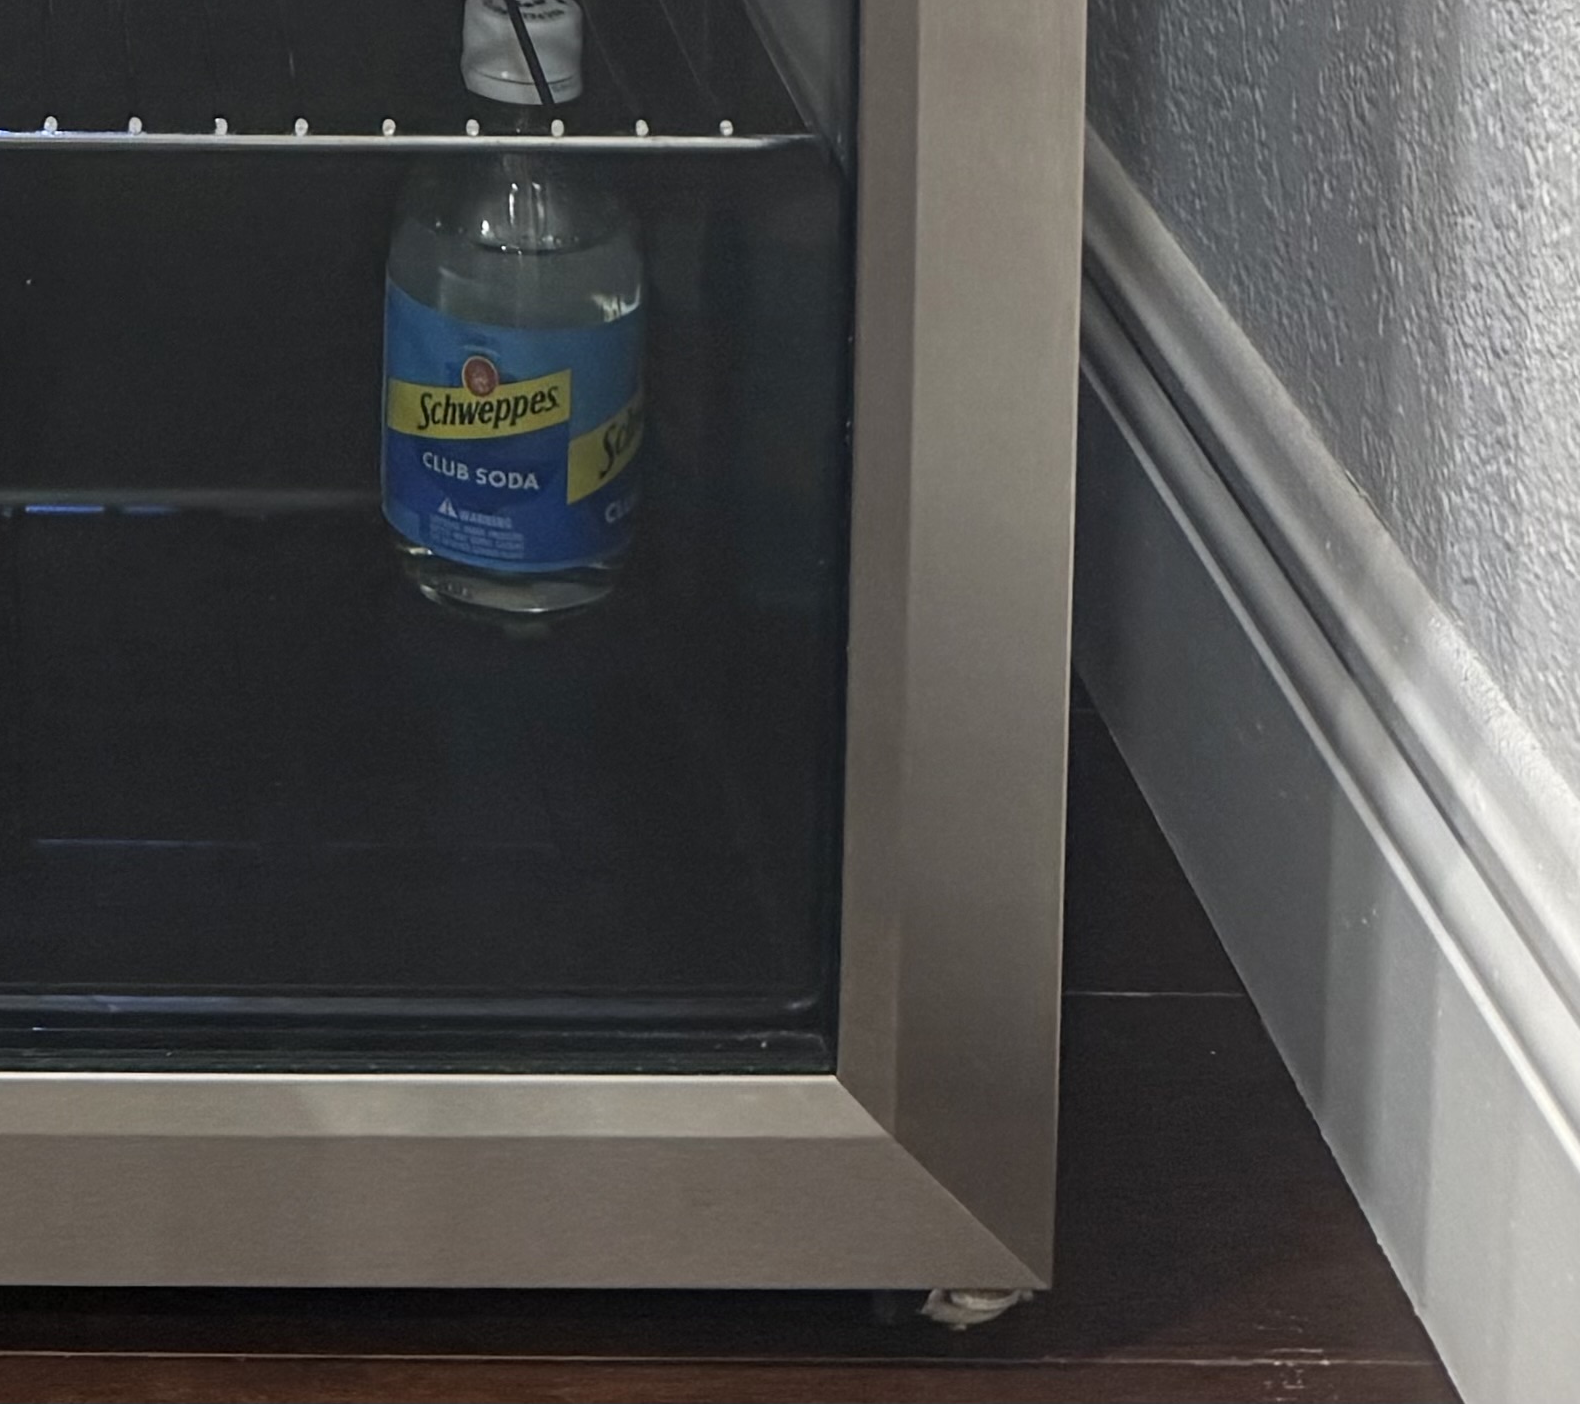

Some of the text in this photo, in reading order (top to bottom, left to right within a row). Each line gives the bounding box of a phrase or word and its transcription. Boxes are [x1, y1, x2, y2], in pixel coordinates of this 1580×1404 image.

[417, 386, 561, 431] Schweppes
[422, 451, 540, 491] CLUB SODA
